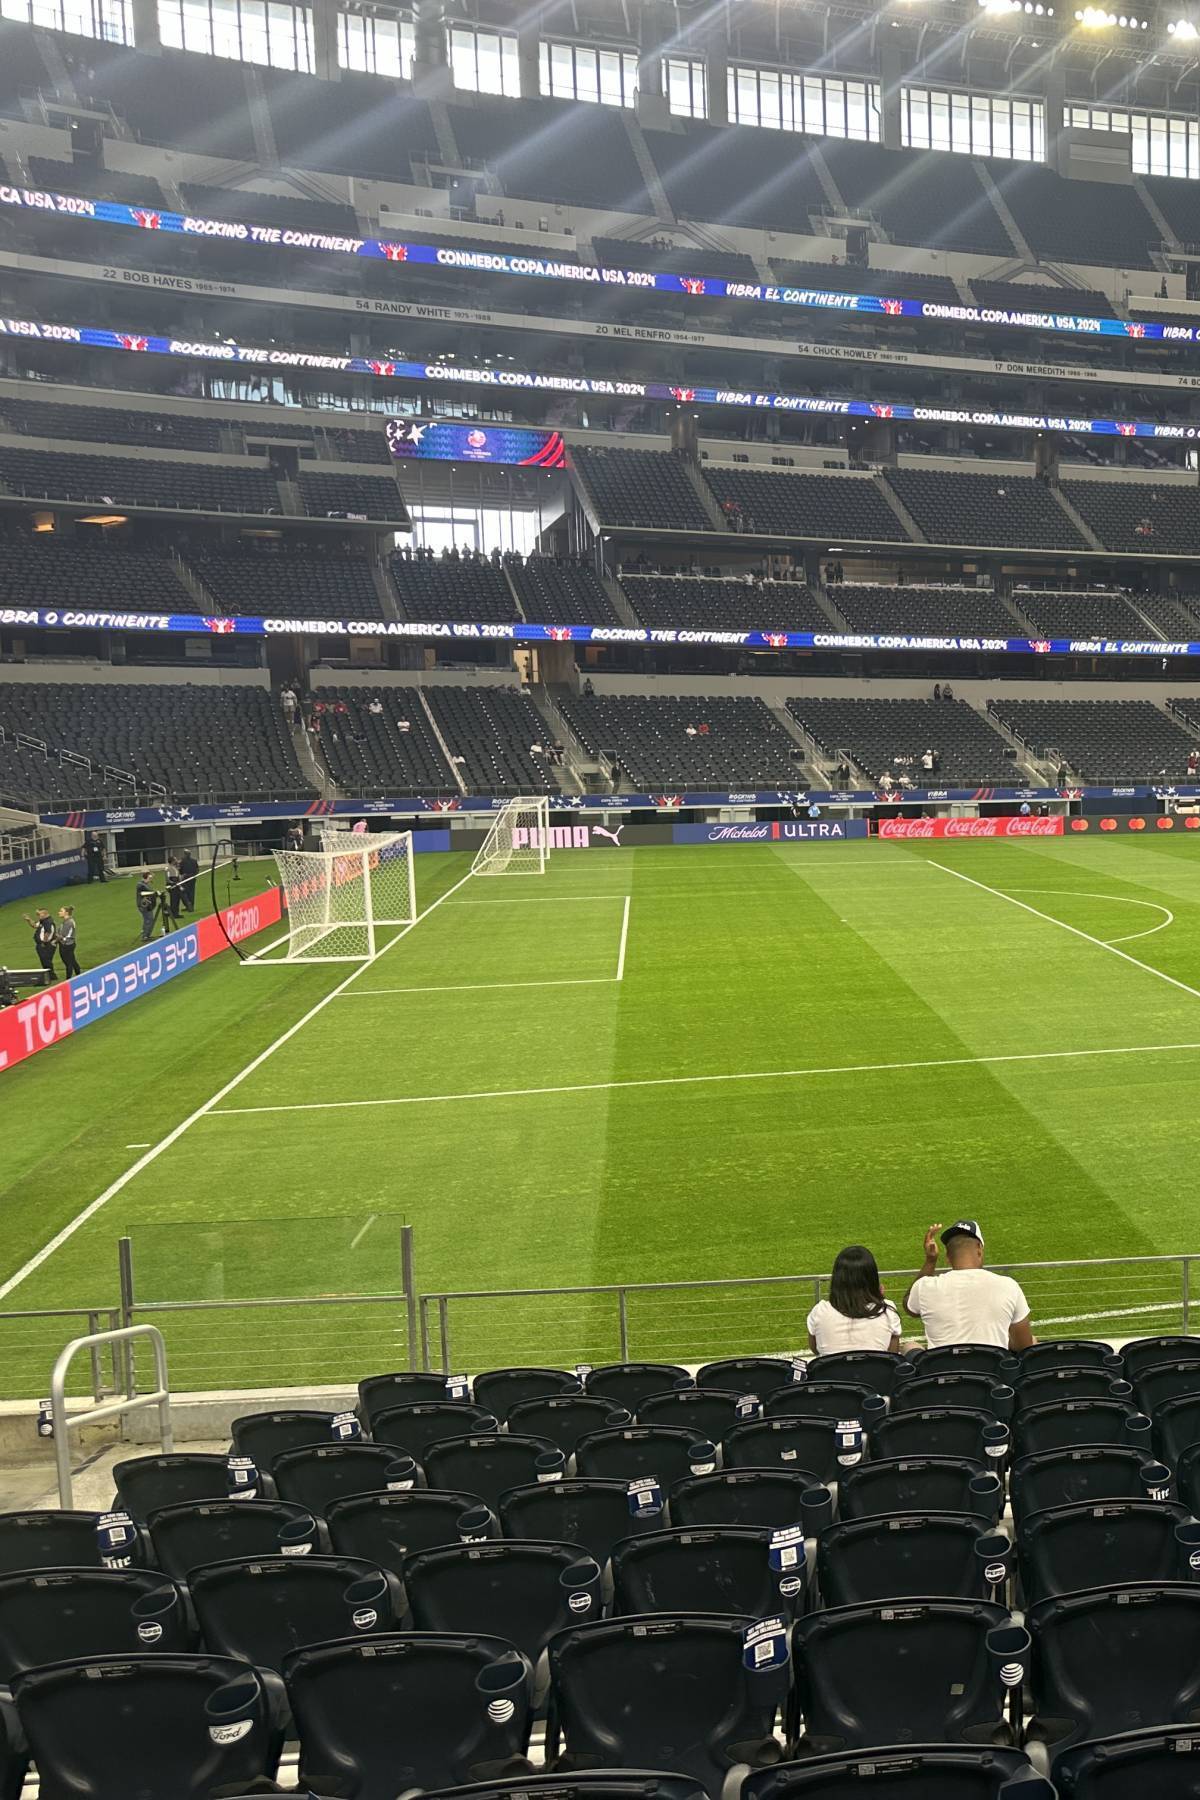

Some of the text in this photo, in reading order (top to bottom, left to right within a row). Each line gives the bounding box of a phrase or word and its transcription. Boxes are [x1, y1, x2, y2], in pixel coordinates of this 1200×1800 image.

[25, 191, 55, 210] USA
[56, 197, 95, 216] 2024
[183, 217, 364, 252] ROCKING THE CONTINENT
[437, 250, 656, 287] CONMEBOL COPA AMERICA USA 2024
[103, 269, 117, 279] 22
[123, 271, 149, 283] BOB
[153, 274, 192, 289] HAYES
[726, 283, 859, 307] VIBRA EL CONTINENTE
[356, 300, 370, 310] 54
[375, 302, 412, 314] RANDY
[416, 305, 451, 318] WHITE
[923, 303, 1100, 332] CONMEBOL COPA AMERICA USA 2024
[10, 323, 80, 341] USA 2024
[595, 326, 608, 334] 20
[613, 327, 633, 337] MEL
[635, 329, 671, 340] RENFRO
[1162, 326, 1192, 340] VIBRA
[169, 341, 352, 370] ROCKING THE CONTINENT
[813, 347, 840, 356] CHUCK
[843, 349, 878, 359] HOWLEY
[1007, 365, 1023, 373] DON
[1026, 366, 1065, 376] MEREDITH
[425, 366, 646, 396] CONMEBOL COPA AMERICA USA 2024
[1178, 377, 1188, 385] 74
[715, 391, 849, 412] VIBRA EL CONTINENTE
[0, 610, 169, 629] BRA O CONTINENTE
[264, 620, 514, 637] CONMEBOL COPA AMERICA USA 2024
[590, 628, 751, 643] ROCKING THE CONTINENT
[813, 634, 1008, 650] CONMEBOL COPA AMERICA USA 2024
[1070, 641, 1189, 653] VIBRA EL CONTINENTE
[512, 825, 589, 848] PUMA
[708, 823, 843, 840] Michelob ULTRA
[226, 905, 259, 941] Betano
[17, 990, 73, 1052] TCL
[781, 1581, 800, 1590] PEPSI
[569, 1597, 590, 1606] PEPSI
[354, 1613, 377, 1623] PEPSI
[139, 1628, 161, 1636] PEPSI
[213, 1725, 243, 1741] Ford
